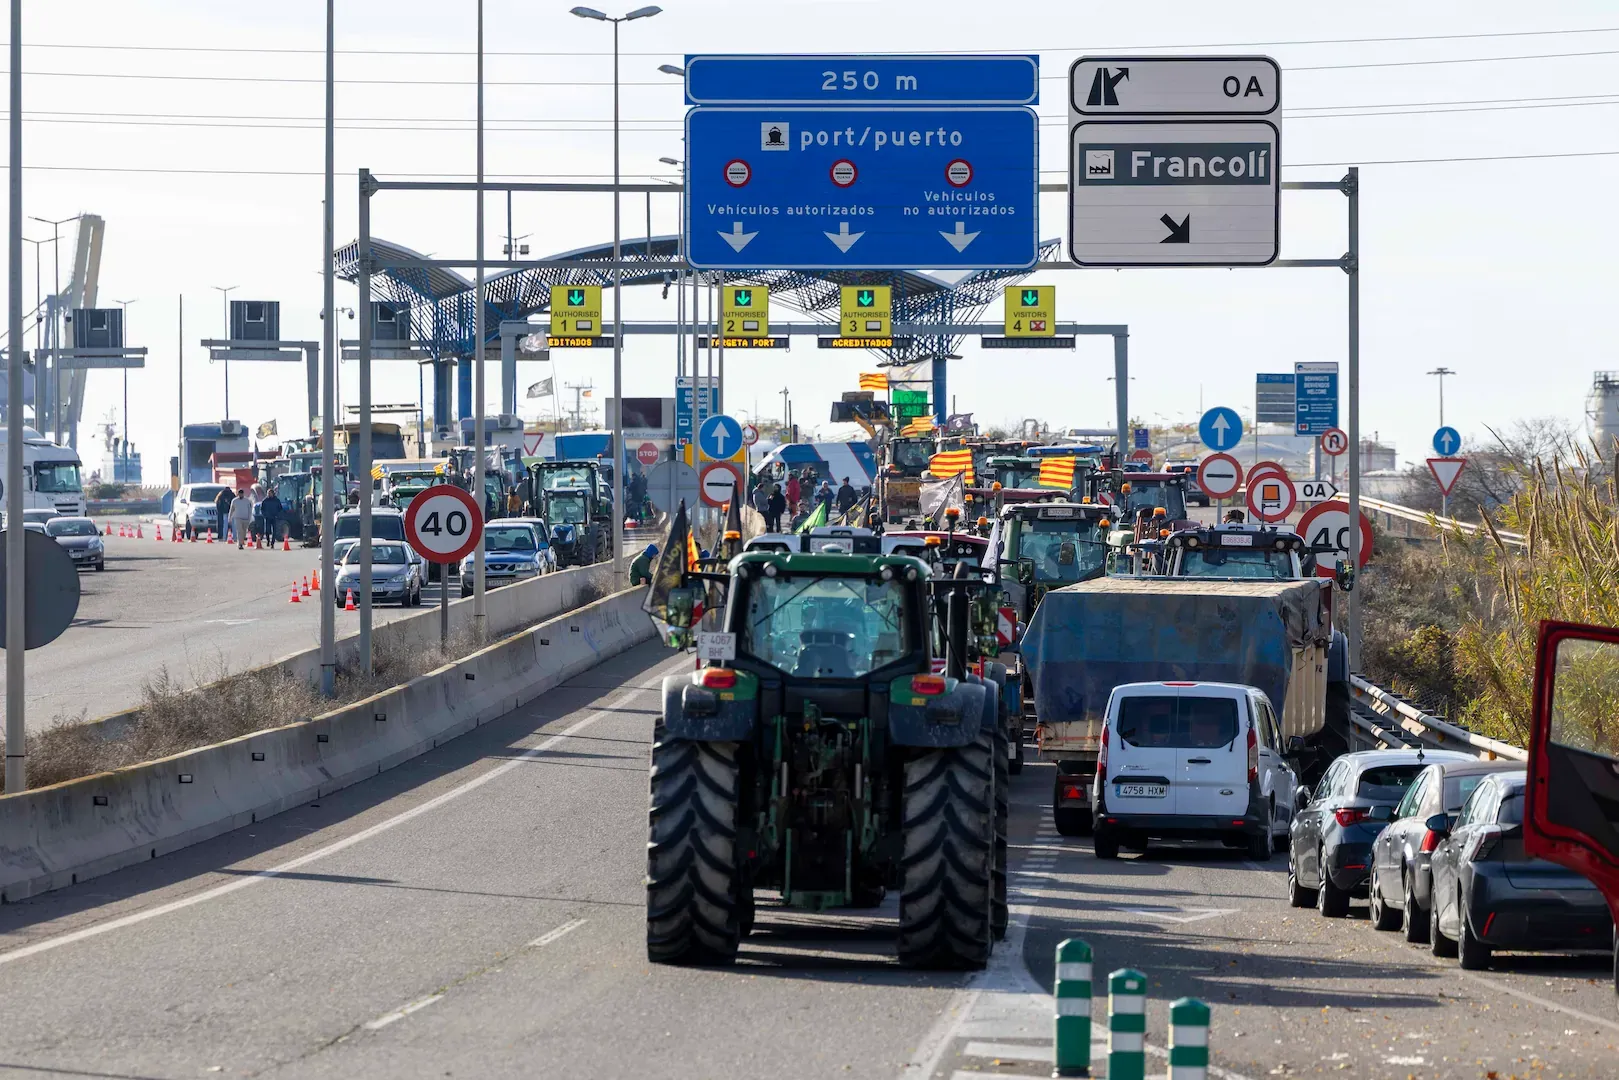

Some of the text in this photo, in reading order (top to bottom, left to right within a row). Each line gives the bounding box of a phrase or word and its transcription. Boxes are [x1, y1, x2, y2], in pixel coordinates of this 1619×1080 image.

[821, 71, 918, 91] 250 m
[800, 126, 963, 152] port/puerto
[1131, 149, 1268, 178] Francolí
[923, 190, 996, 202] Vehículos
[707, 203, 875, 216] Vehículos autorizados
[903, 204, 1016, 216] no autorizados
[560, 320, 567, 332] 1
[726, 320, 735, 332] 2
[849, 320, 858, 333] 3
[1013, 320, 1022, 332] 4
[548, 338, 592, 346] EDITADOS
[753, 338, 775, 347] PORT
[832, 338, 892, 347] ACREDITADOS
[420, 510, 467, 537] 40
[710, 635, 732, 645] 4067
[1122, 784, 1165, 795] 4758 HXM
